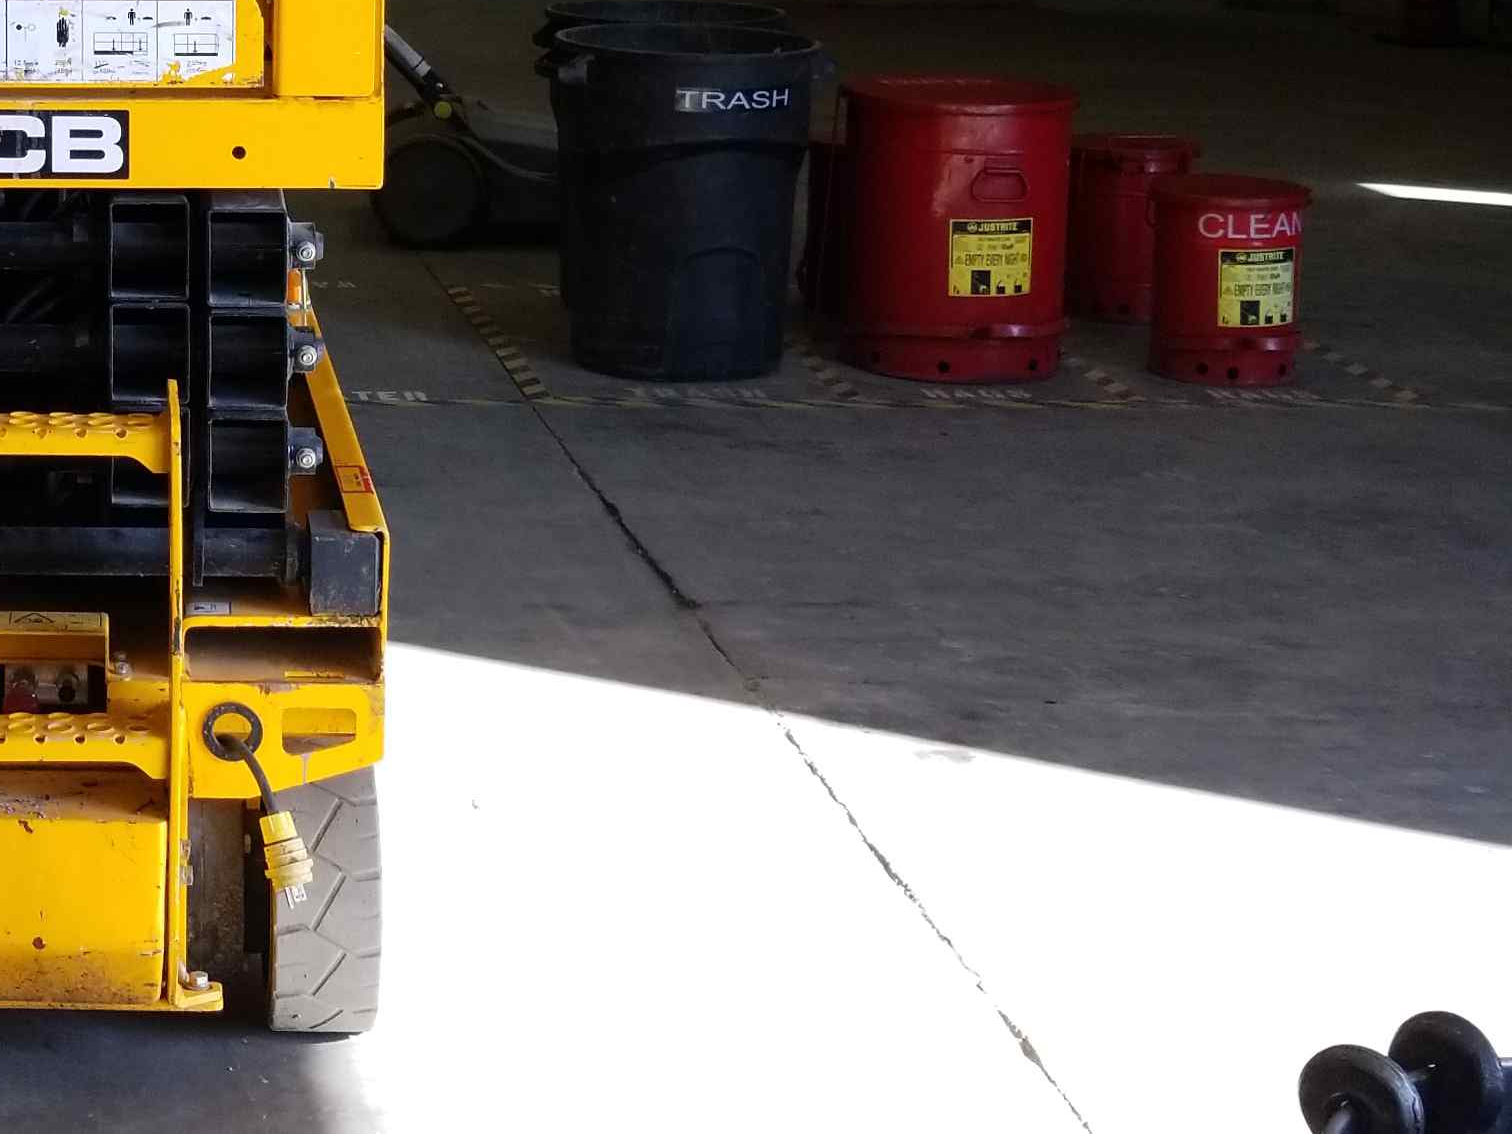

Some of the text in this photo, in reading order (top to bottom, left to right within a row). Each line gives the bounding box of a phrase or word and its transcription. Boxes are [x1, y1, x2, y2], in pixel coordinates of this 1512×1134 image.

[676, 88, 789, 110] TRASH
[978, 222, 1018, 233] JUSTRITE
[965, 253, 985, 266] EMPTY
[1247, 251, 1285, 262] JUSTRITE
